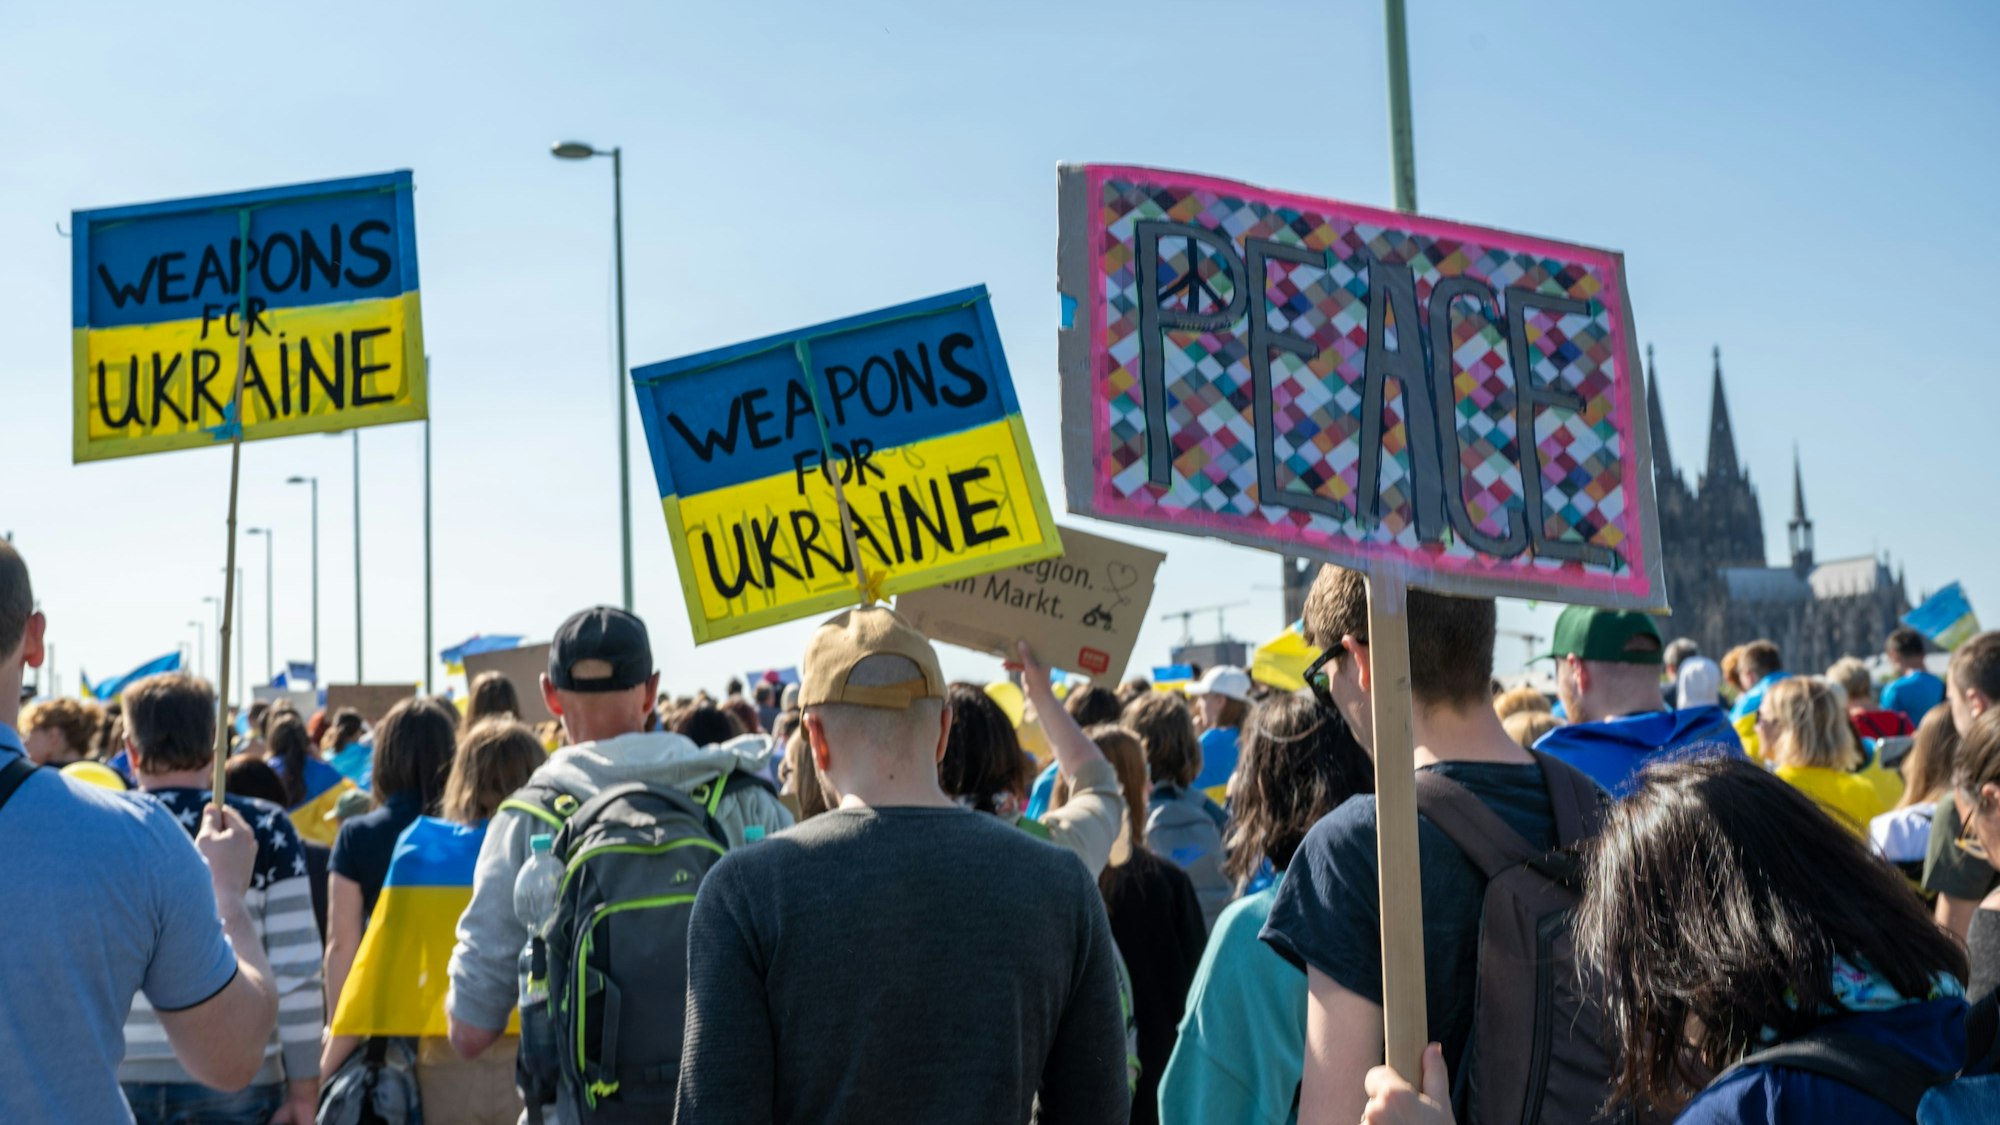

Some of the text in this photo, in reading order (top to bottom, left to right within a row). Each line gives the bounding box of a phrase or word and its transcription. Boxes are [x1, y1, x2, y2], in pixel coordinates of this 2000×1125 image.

[97, 220, 393, 309] WEAPONS
[667, 332, 988, 463] WEAPONS
[1134, 217, 1619, 568] PEACE
[793, 438, 886, 495] FOR
[702, 466, 1010, 600] UKRAINE
[1016, 556, 1094, 590] egion.
[982, 574, 1064, 620] Markt.
